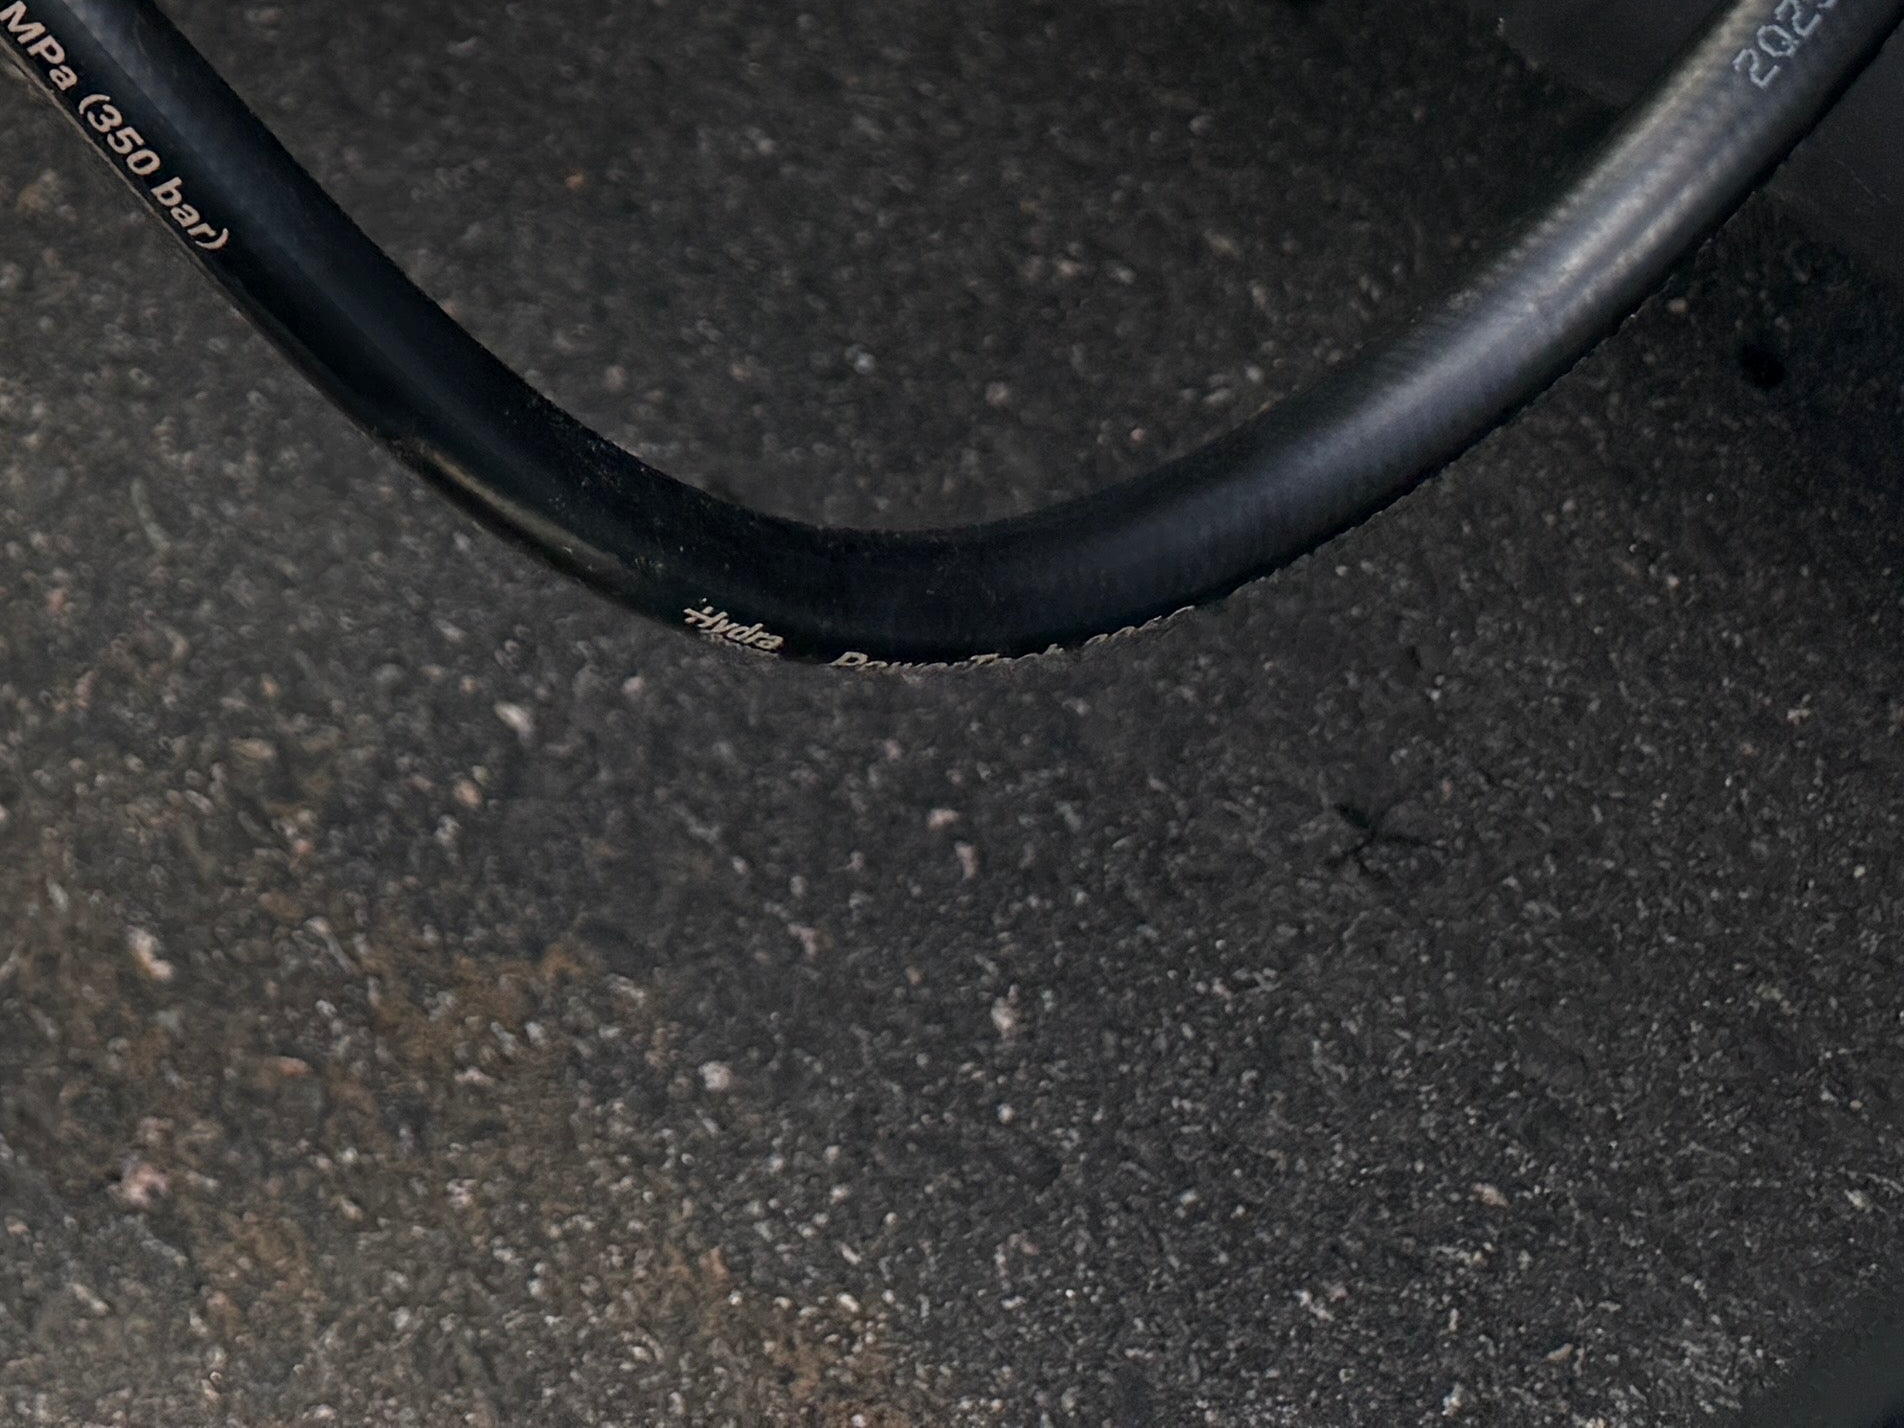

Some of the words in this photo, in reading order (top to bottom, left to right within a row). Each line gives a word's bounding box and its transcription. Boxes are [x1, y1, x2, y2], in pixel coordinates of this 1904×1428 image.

[79, 94, 161, 176] (350
[150, 176, 229, 250] bar)
[683, 600, 784, 650] Hydra
